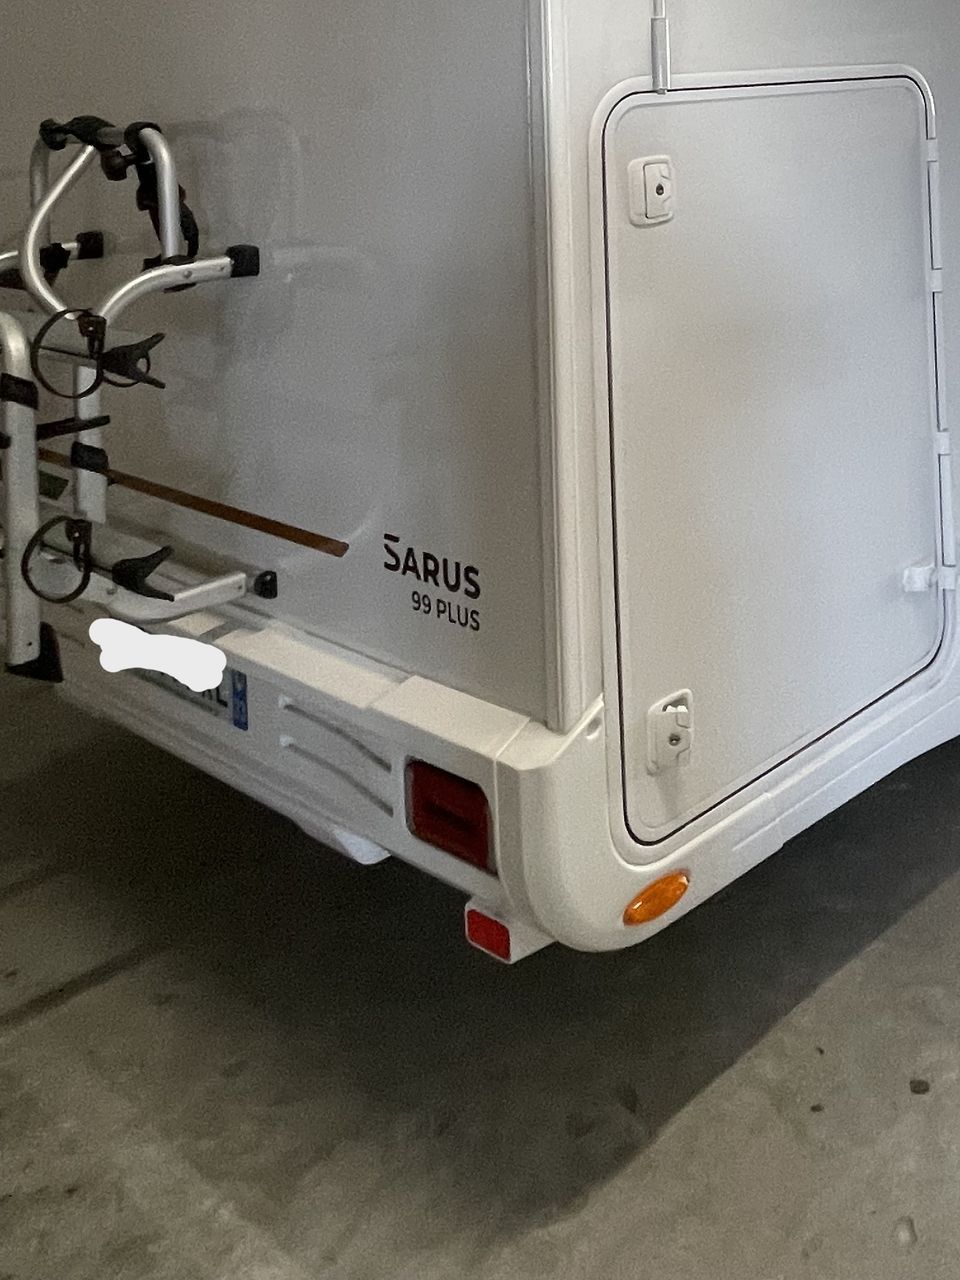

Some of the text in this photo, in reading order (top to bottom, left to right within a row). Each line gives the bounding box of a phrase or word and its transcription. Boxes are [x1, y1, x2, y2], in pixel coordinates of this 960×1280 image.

[383, 533, 481, 600] SARUS
[411, 590, 480, 631] 99 PLUS
